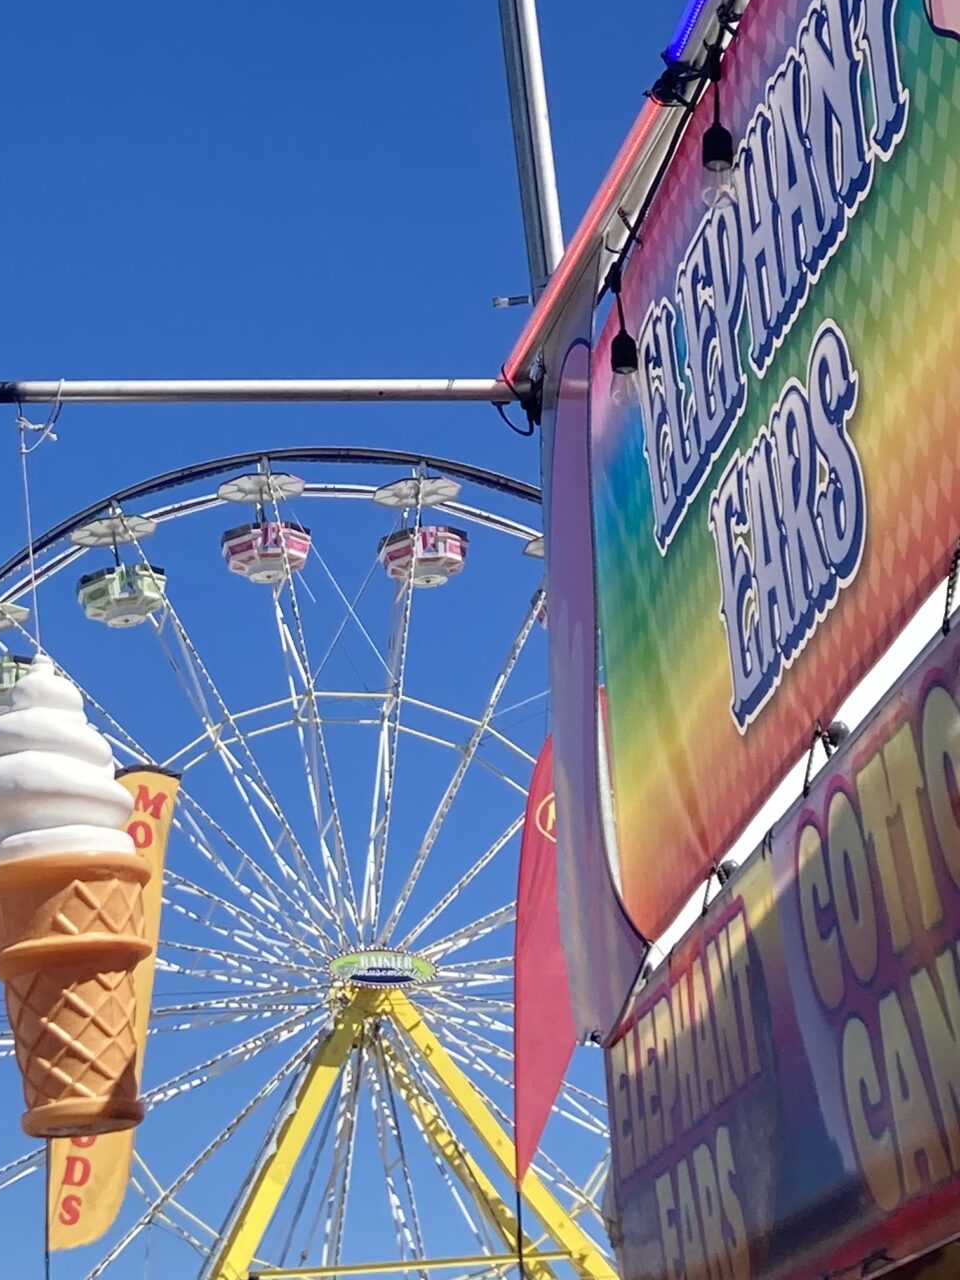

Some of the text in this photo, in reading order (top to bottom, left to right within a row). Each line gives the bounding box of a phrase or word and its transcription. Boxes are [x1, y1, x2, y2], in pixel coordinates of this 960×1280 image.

[709, 318, 866, 736] EARS
[359, 955, 414, 969] RAINIER
[611, 908, 762, 1182] ELEPHANT
